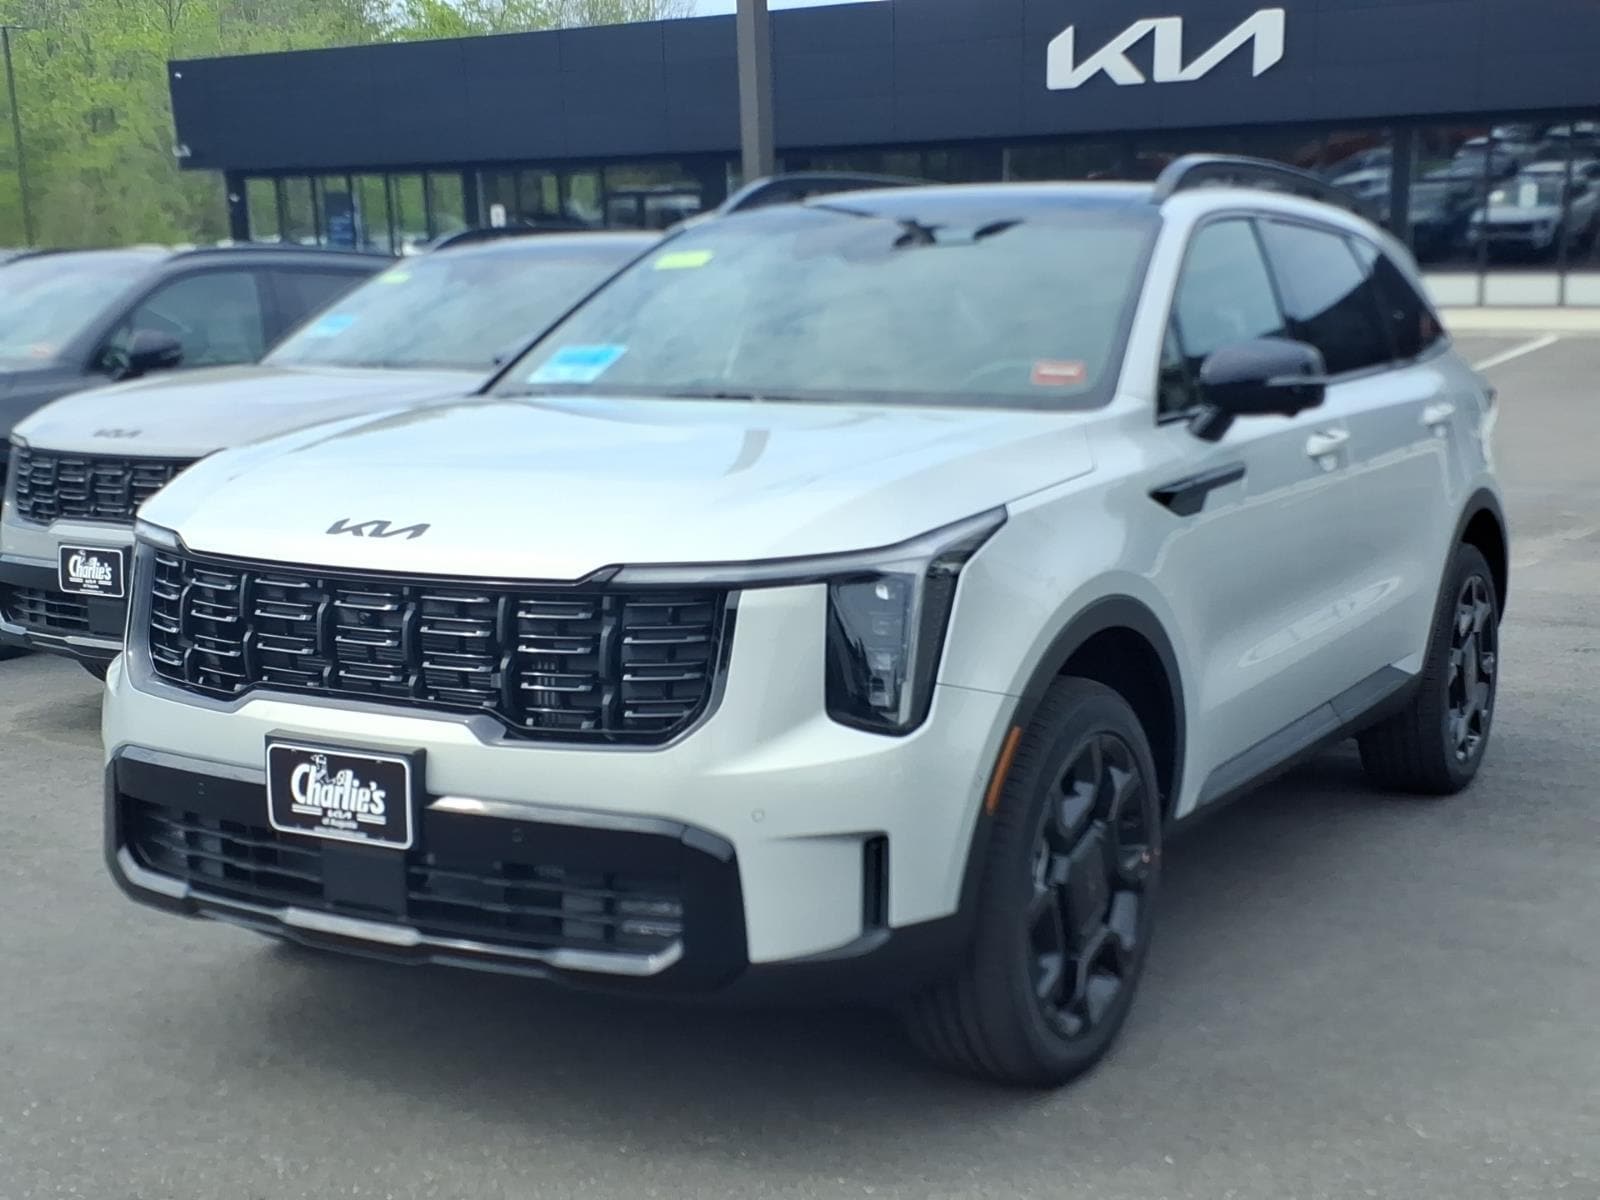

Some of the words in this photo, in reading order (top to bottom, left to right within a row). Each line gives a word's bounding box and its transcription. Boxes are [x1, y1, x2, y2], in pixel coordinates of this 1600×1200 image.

[1046, 8, 1285, 90] KIA
[325, 518, 431, 540] KIA
[68, 554, 112, 581] Charlie's
[291, 763, 386, 815] Charlie's
